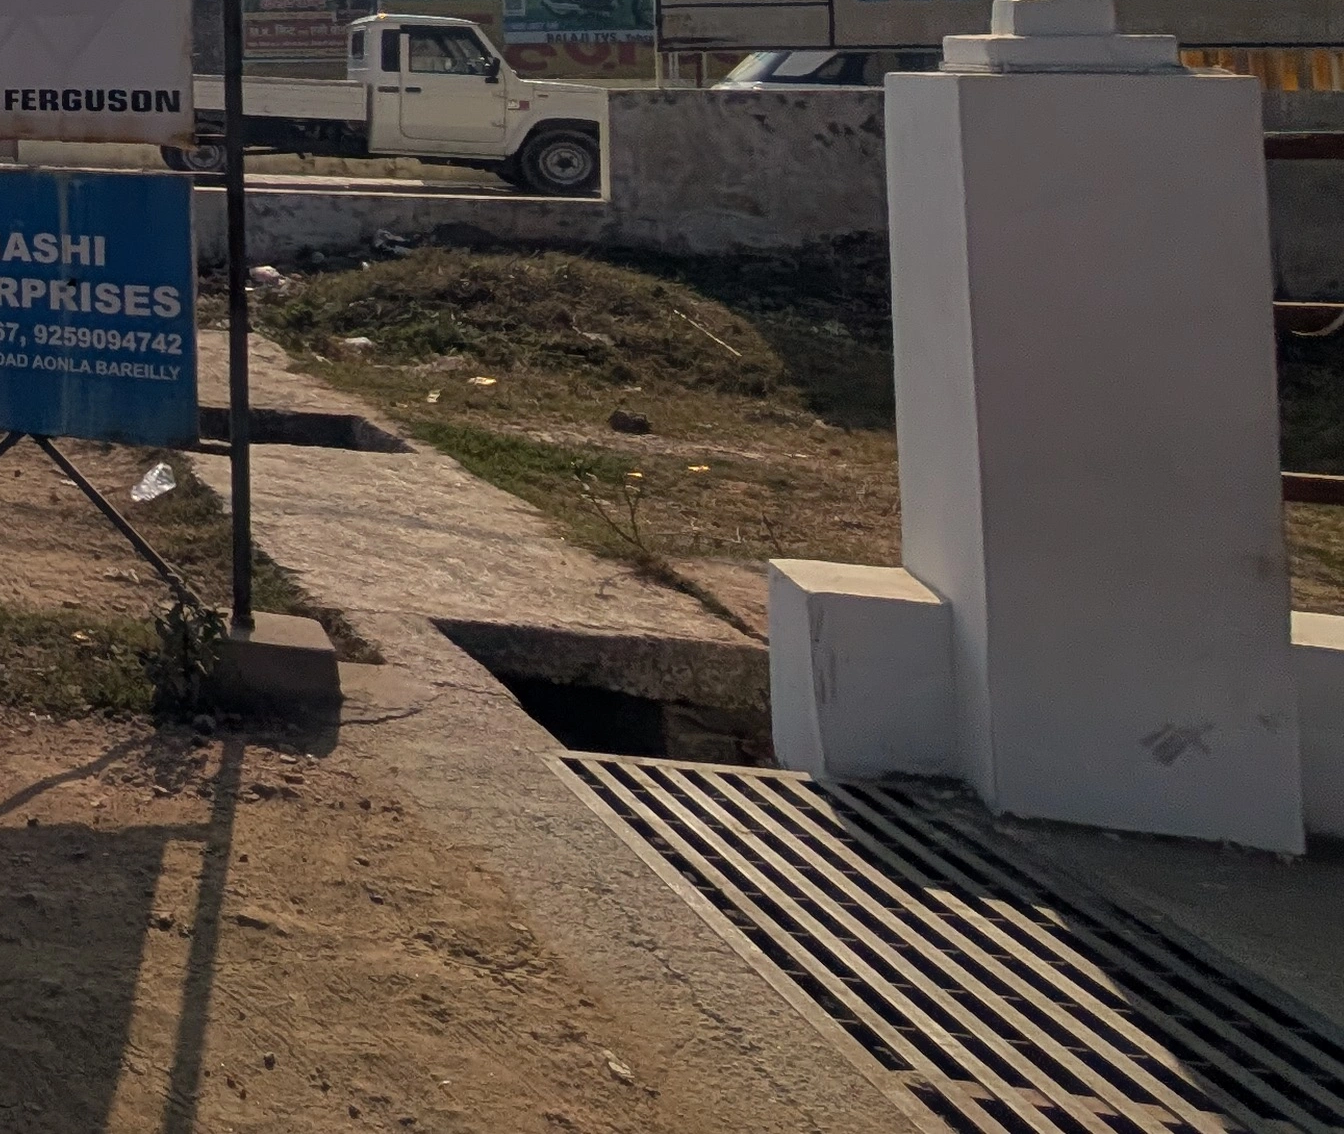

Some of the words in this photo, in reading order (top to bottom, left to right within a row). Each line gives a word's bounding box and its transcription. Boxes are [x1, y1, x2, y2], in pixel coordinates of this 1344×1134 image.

[5, 88, 182, 113] FERGUSON
[34, 324, 182, 355] 9259094742
[32, 355, 92, 374] AONLA
[95, 362, 181, 381] BAREILLY
